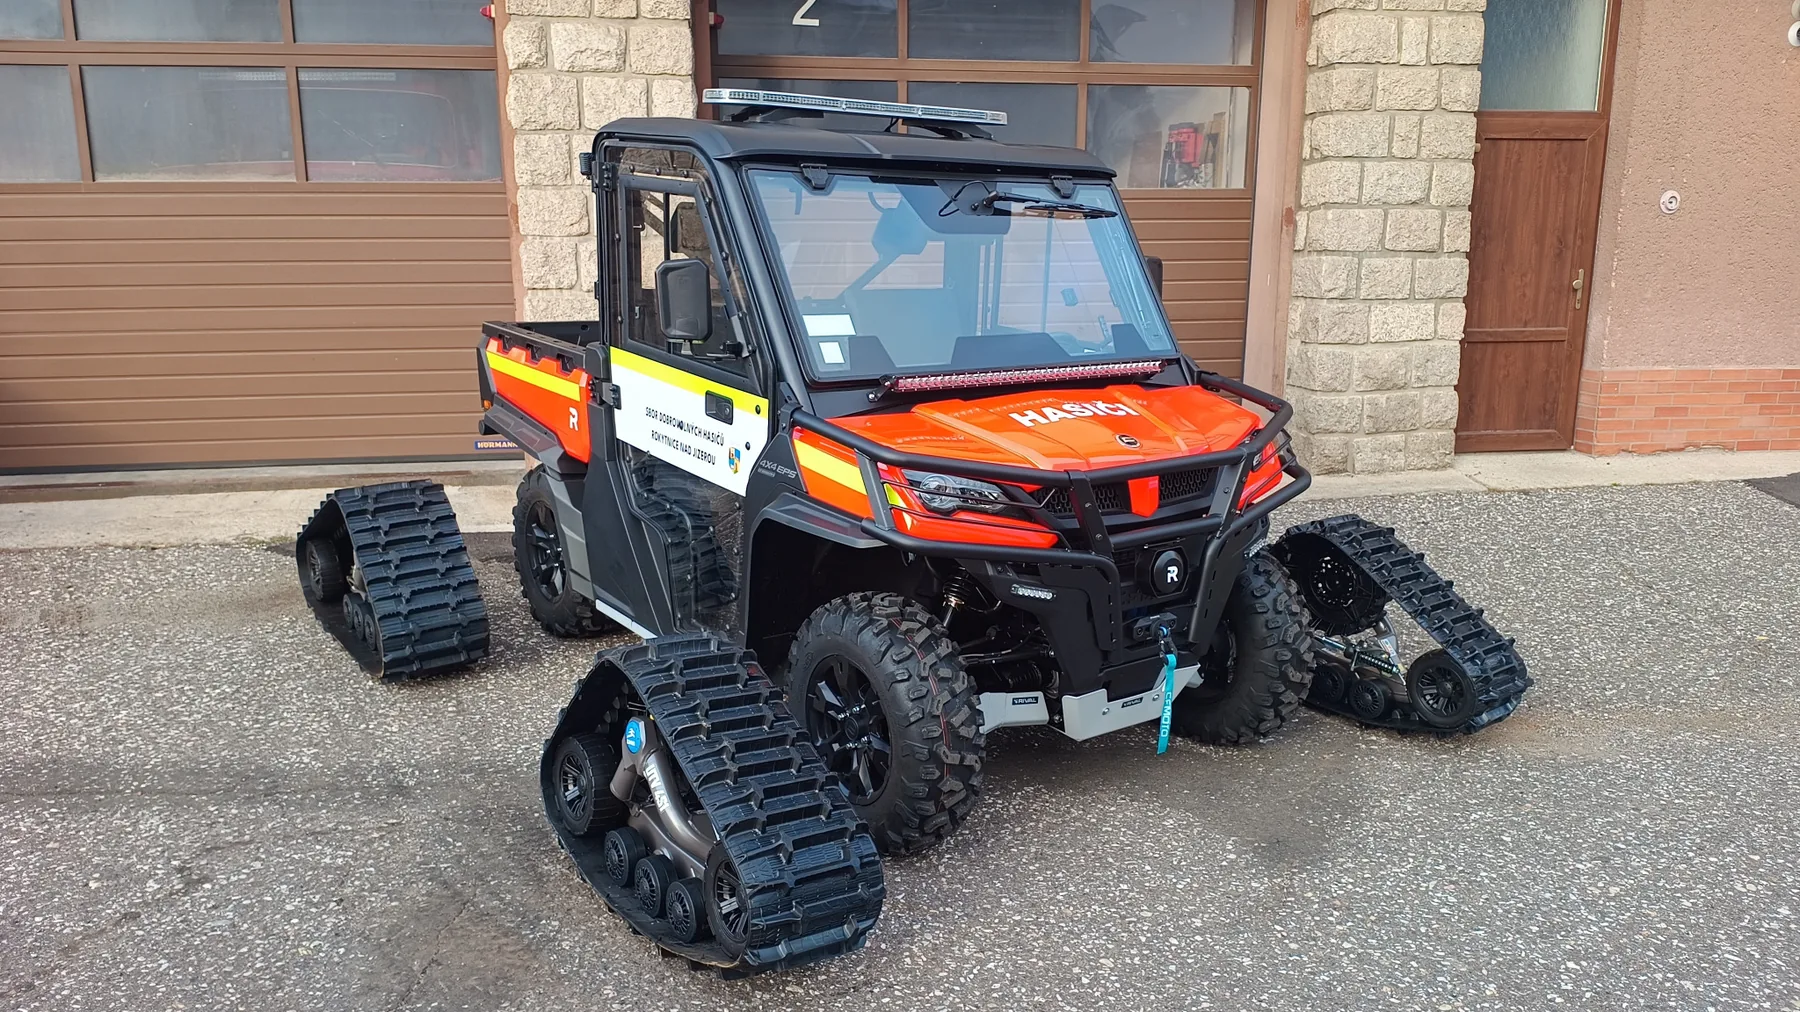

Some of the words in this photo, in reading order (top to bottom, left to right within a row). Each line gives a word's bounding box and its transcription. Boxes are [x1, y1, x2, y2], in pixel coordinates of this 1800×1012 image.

[645, 406, 659, 421] SBOR
[659, 411, 702, 438] DOBROVLNÝCH
[1008, 401, 1140, 427] HASIČI
[651, 429, 680, 451] ROKYTNICE
[680, 441, 692, 456] NAD
[692, 447, 717, 466] JIZEROU
[777, 465, 798, 479] EPS
[1167, 565, 1179, 583] R
[1161, 691, 1172, 737] CFMOTO
